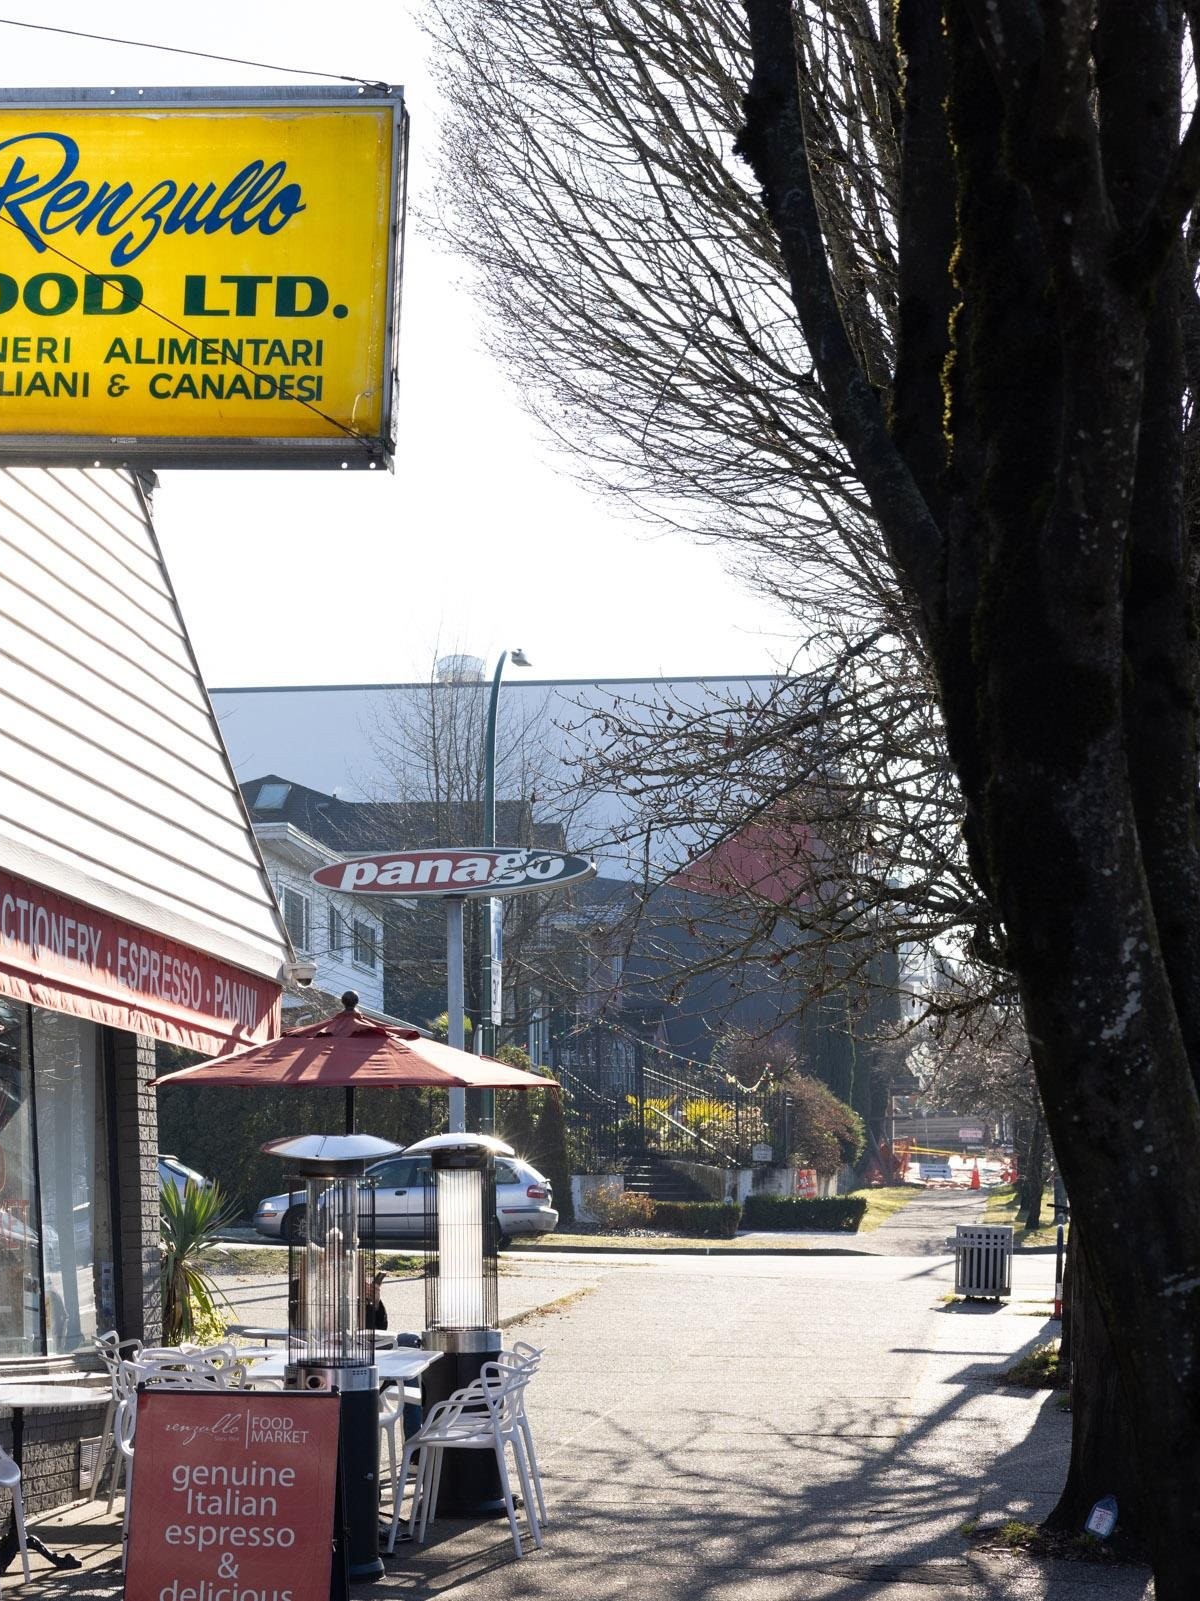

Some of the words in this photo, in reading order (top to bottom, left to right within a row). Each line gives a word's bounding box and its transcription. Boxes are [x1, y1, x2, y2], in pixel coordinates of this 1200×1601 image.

[184, 275, 348, 319] LTD.
[104, 338, 323, 367] ALIMENTARI
[107, 374, 130, 397] &
[149, 374, 322, 402] CANADESI
[340, 850, 565, 890] panago
[118, 937, 202, 1010] ESPRESSO
[215, 975, 258, 1029] PANINI
[163, 1413, 242, 1446] renzullo
[251, 1430, 309, 1444] MARKET
[252, 1416, 294, 1429] FOOD
[171, 1461, 296, 1492] genuine
[187, 1488, 278, 1517] Italian
[165, 1524, 296, 1552] espresso
[217, 1552, 239, 1579] &
[159, 1579, 293, 1601] delicious
